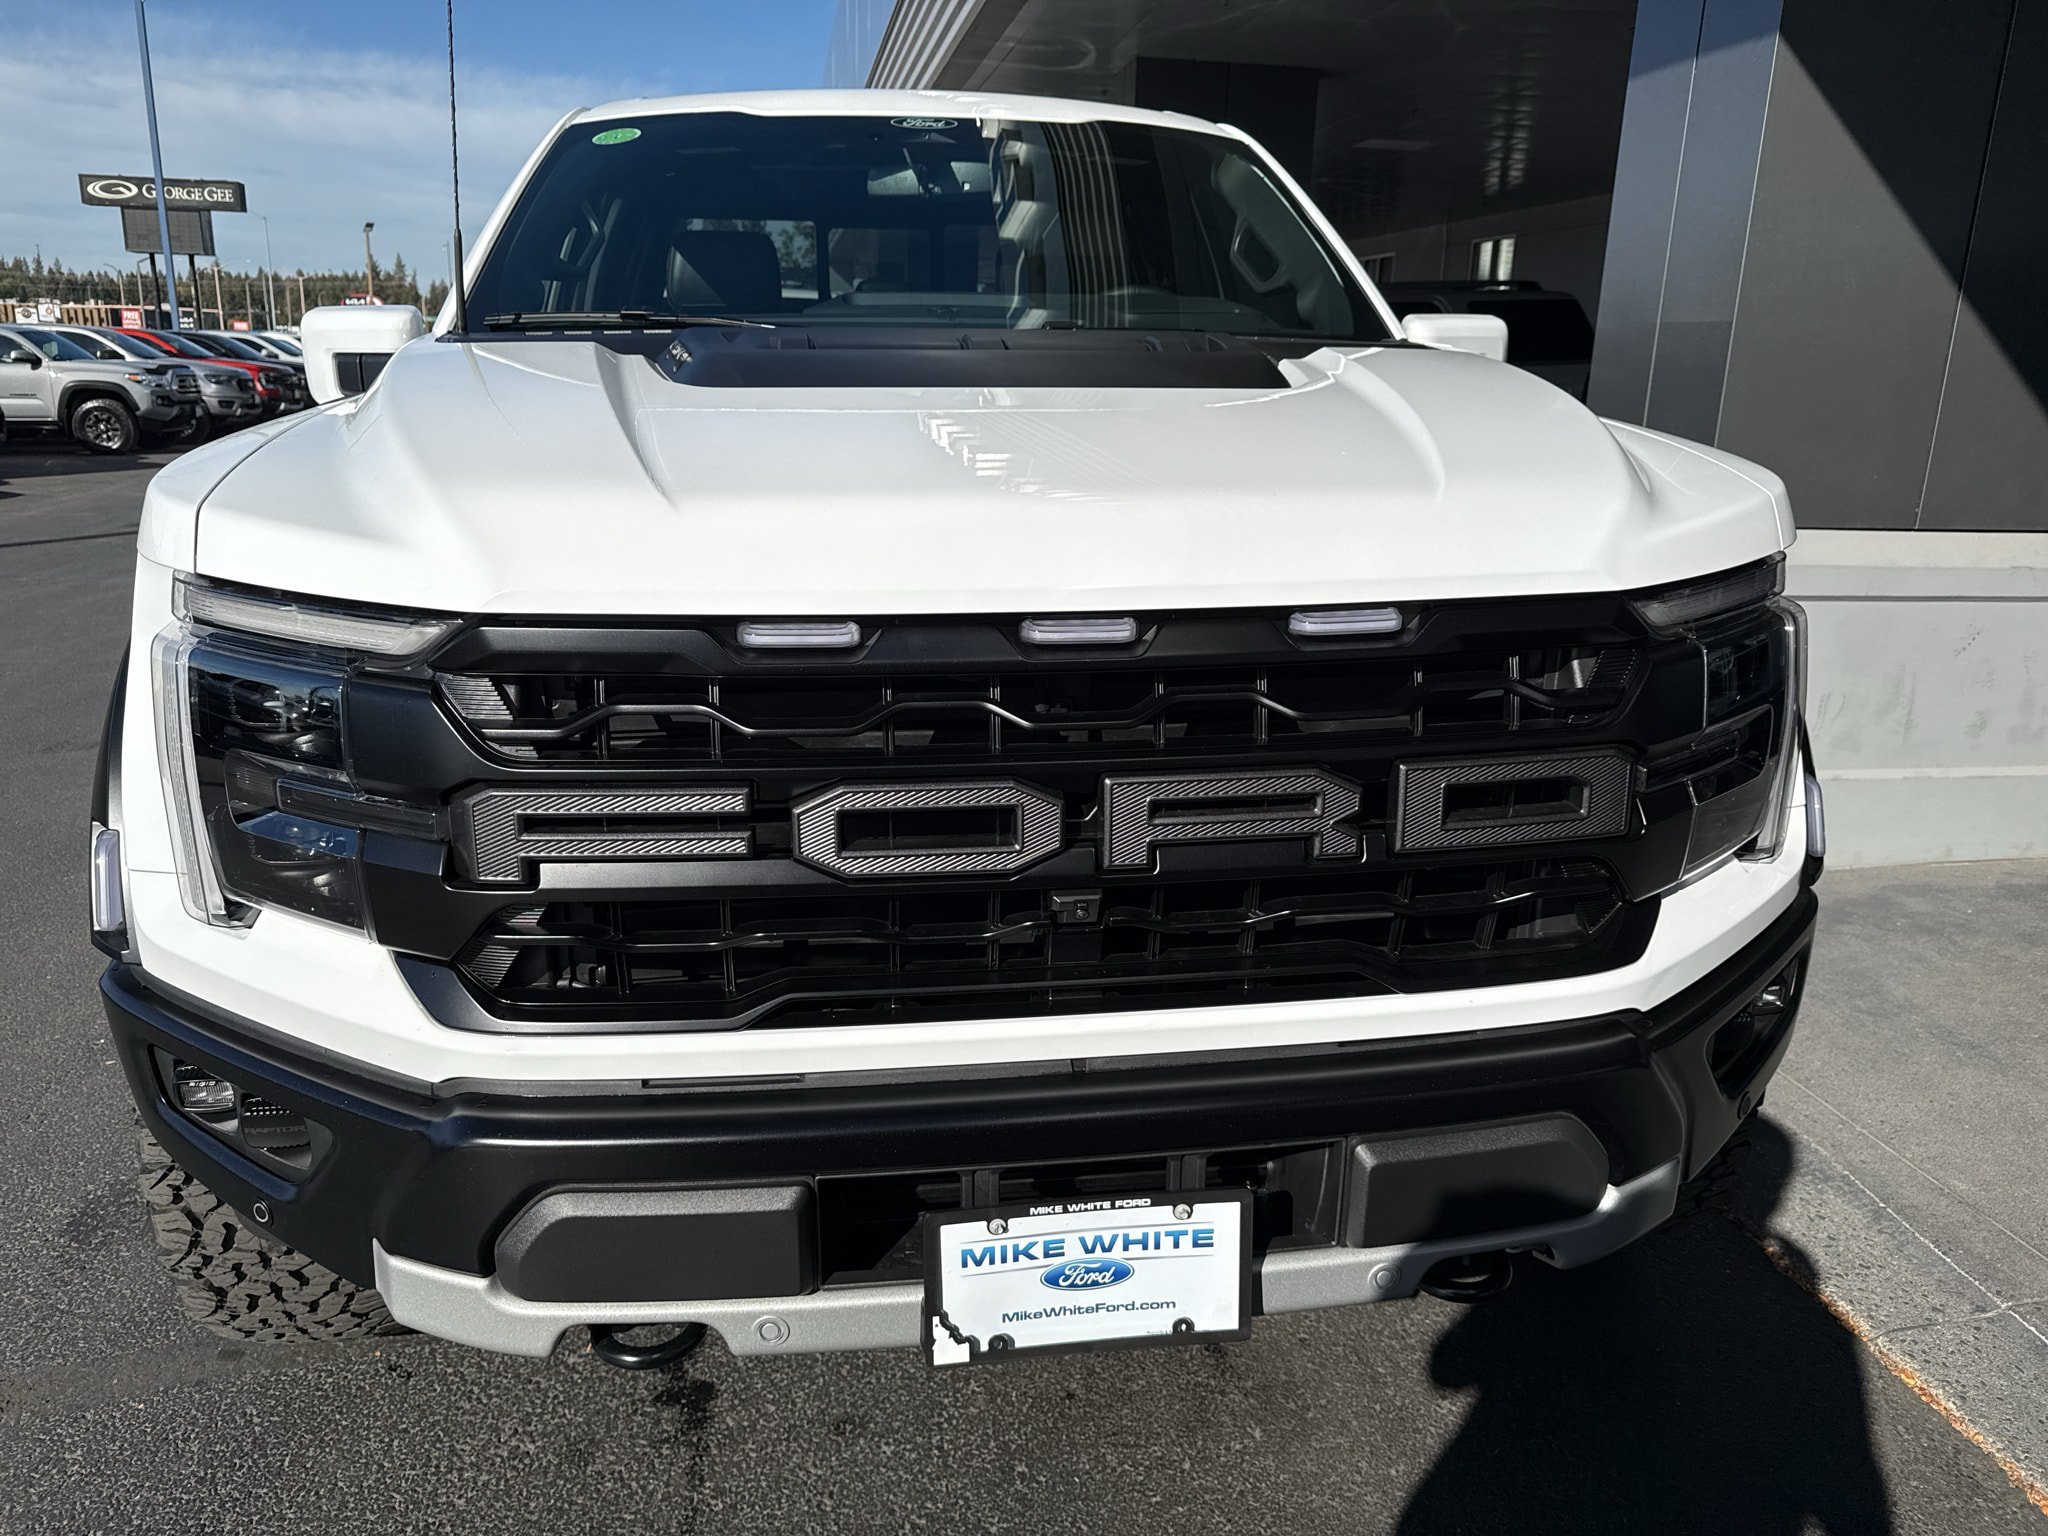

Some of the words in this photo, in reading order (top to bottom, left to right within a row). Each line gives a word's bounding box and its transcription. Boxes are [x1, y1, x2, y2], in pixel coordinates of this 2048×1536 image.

[142, 183, 203, 200] GORGE
[204, 186, 234, 202] GEE
[470, 750, 1634, 884] FORD
[244, 1125, 307, 1135] RAPTOR
[1029, 1205, 1064, 1216] MIKE
[1066, 1201, 1111, 1212] WHITE
[1114, 1198, 1151, 1209] FORD
[961, 1238, 1066, 1269] MIKE
[1078, 1228, 1215, 1255] WHITE
[1058, 1262, 1115, 1287] Ford
[1002, 1301, 1177, 1324] MikeWhiteFord.com
